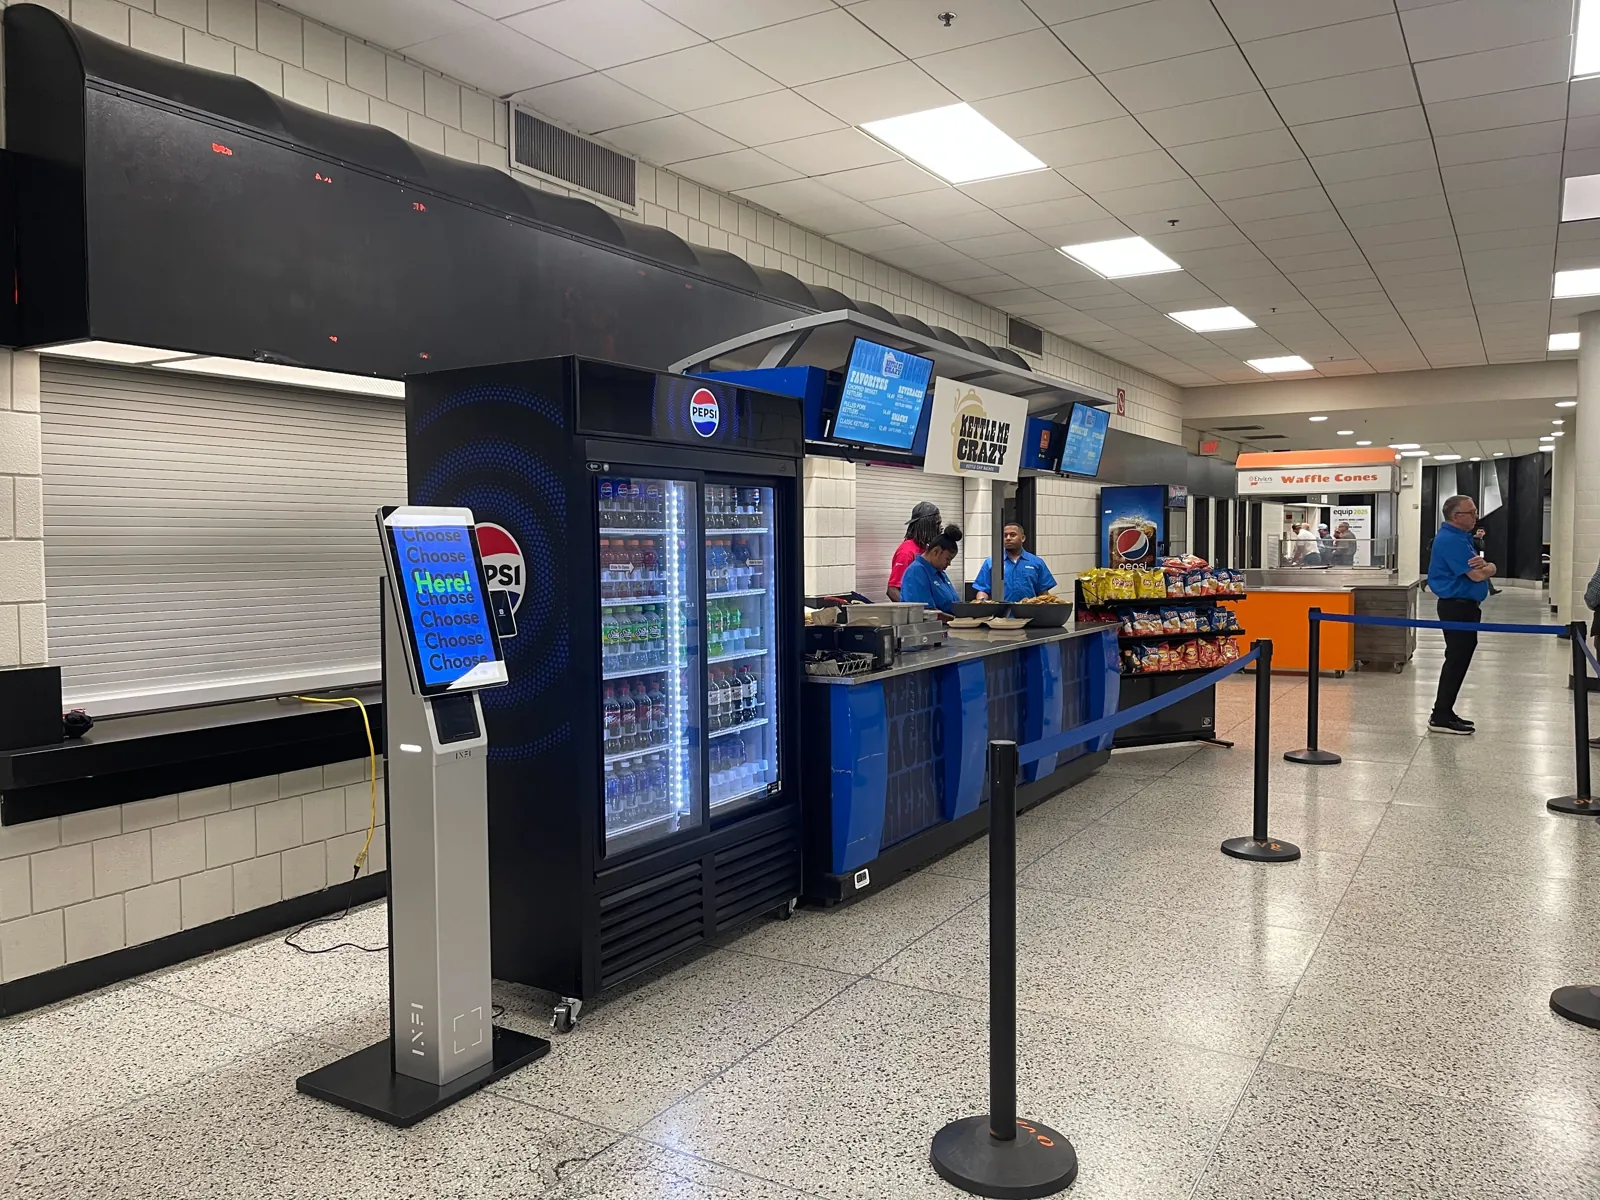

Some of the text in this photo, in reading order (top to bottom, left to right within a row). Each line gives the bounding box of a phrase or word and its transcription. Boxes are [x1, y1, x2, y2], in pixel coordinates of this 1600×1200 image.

[850, 371, 889, 391] FAVORITES
[692, 406, 717, 420] PEPSI
[960, 414, 1010, 444] KETTLE ME
[957, 438, 1007, 465] CRAZY
[1281, 474, 1330, 484] Waffle
[1334, 473, 1378, 482] Cones
[1333, 508, 1353, 516] equip
[402, 526, 461, 542] Choose
[407, 546, 466, 563] Choose
[414, 570, 472, 594] Here!
[484, 564, 521, 585] PSI
[416, 589, 475, 606] Choose
[420, 610, 479, 628] Choose
[425, 632, 484, 649] Choose
[429, 653, 489, 671] Choose
